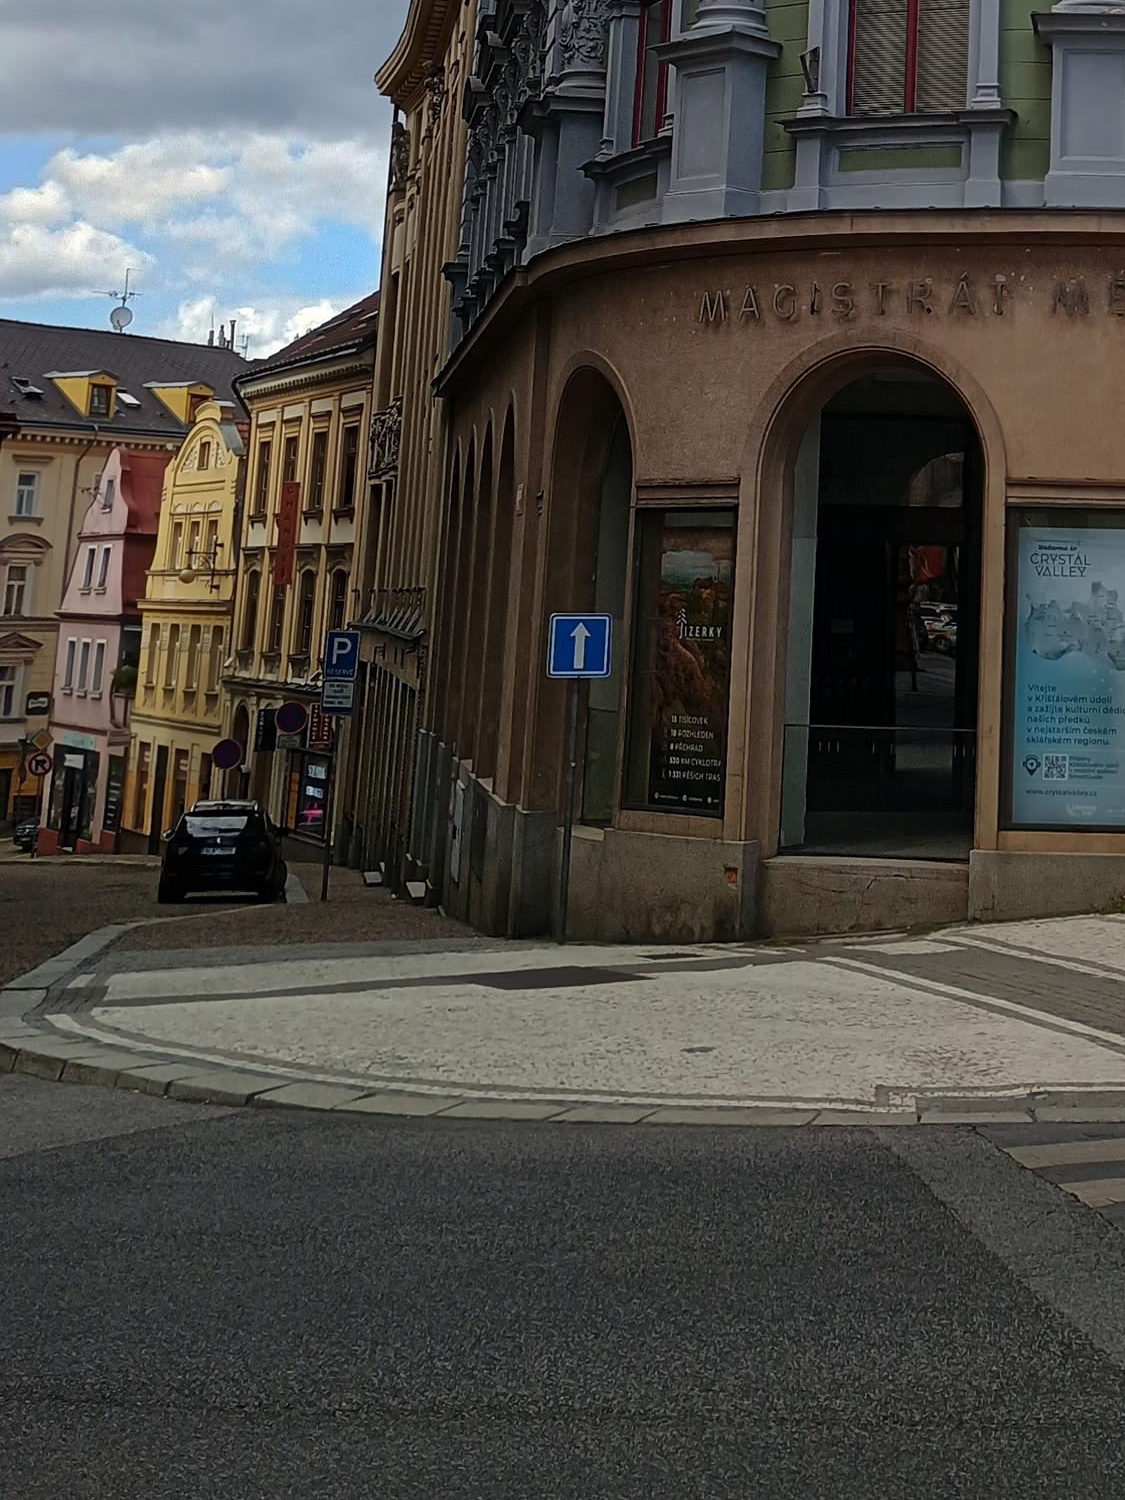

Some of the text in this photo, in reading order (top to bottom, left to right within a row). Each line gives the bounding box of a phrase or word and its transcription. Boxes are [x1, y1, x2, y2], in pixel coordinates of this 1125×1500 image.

[699, 271, 1013, 325] MAGISTRÁT
[1030, 552, 1092, 566] CRYSTAL
[1035, 566, 1088, 578] VALLEY
[678, 619, 722, 639] JIZERKY
[332, 638, 352, 664] P
[1028, 684, 1056, 693] Vítejte
[1034, 704, 1063, 714] zažijte
[1028, 715, 1056, 723] našich
[1083, 727, 1117, 735] českém
[1074, 738, 1110, 746] regionu.
